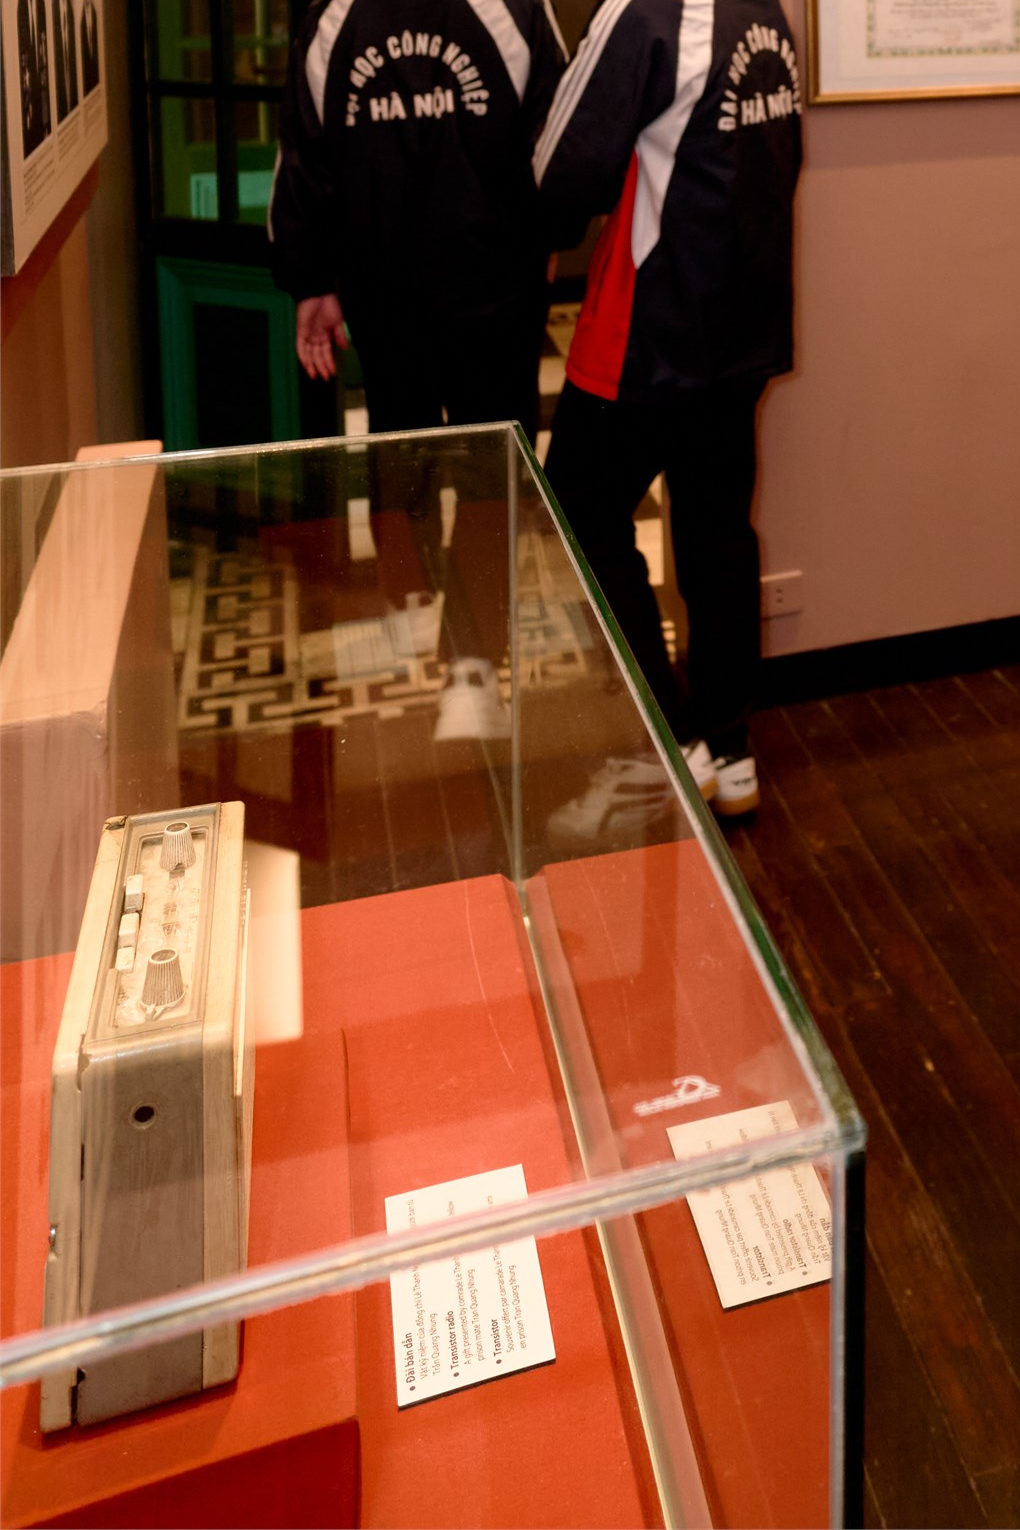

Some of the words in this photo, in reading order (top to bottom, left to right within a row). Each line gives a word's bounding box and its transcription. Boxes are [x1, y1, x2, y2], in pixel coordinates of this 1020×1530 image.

[350, 46, 385, 89] HỌC
[386, 29, 443, 60] CÔNG
[441, 41, 490, 117] NGHIỆP
[369, 90, 408, 122] HÀ
[413, 85, 455, 120] NỘI
[741, 91, 768, 126] HÀ
[467, 1268, 476, 1289] Nhung
[496, 1268, 507, 1297] camarade
[508, 1264, 517, 1286] Nhung
[456, 1281, 466, 1307] comrade
[469, 1288, 478, 1310] Quang
[500, 1297, 510, 1307] par
[511, 1285, 521, 1306] Quang
[445, 1310, 456, 1330] radio
[459, 1307, 468, 1316] by
[471, 1310, 480, 1324] Tran
[501, 1307, 511, 1325] offert
[513, 1306, 523, 1320] Tran
[429, 1312, 439, 1336] Nhung
[460, 1315, 472, 1347] presented
[474, 1324, 482, 1341] mate
[516, 1319, 527, 1341] prison
[402, 1332, 414, 1349] dẫn
[431, 1335, 441, 1359] Quang
[490, 1318, 503, 1357] Transistor
[504, 1324, 515, 1353] Souvenir
[520, 1341, 527, 1349] en
[404, 1349, 415, 1368] bản
[448, 1331, 460, 1370] Transistor
[462, 1348, 474, 1359] gift
[476, 1341, 486, 1361] prison
[405, 1367, 416, 1384] Đài
